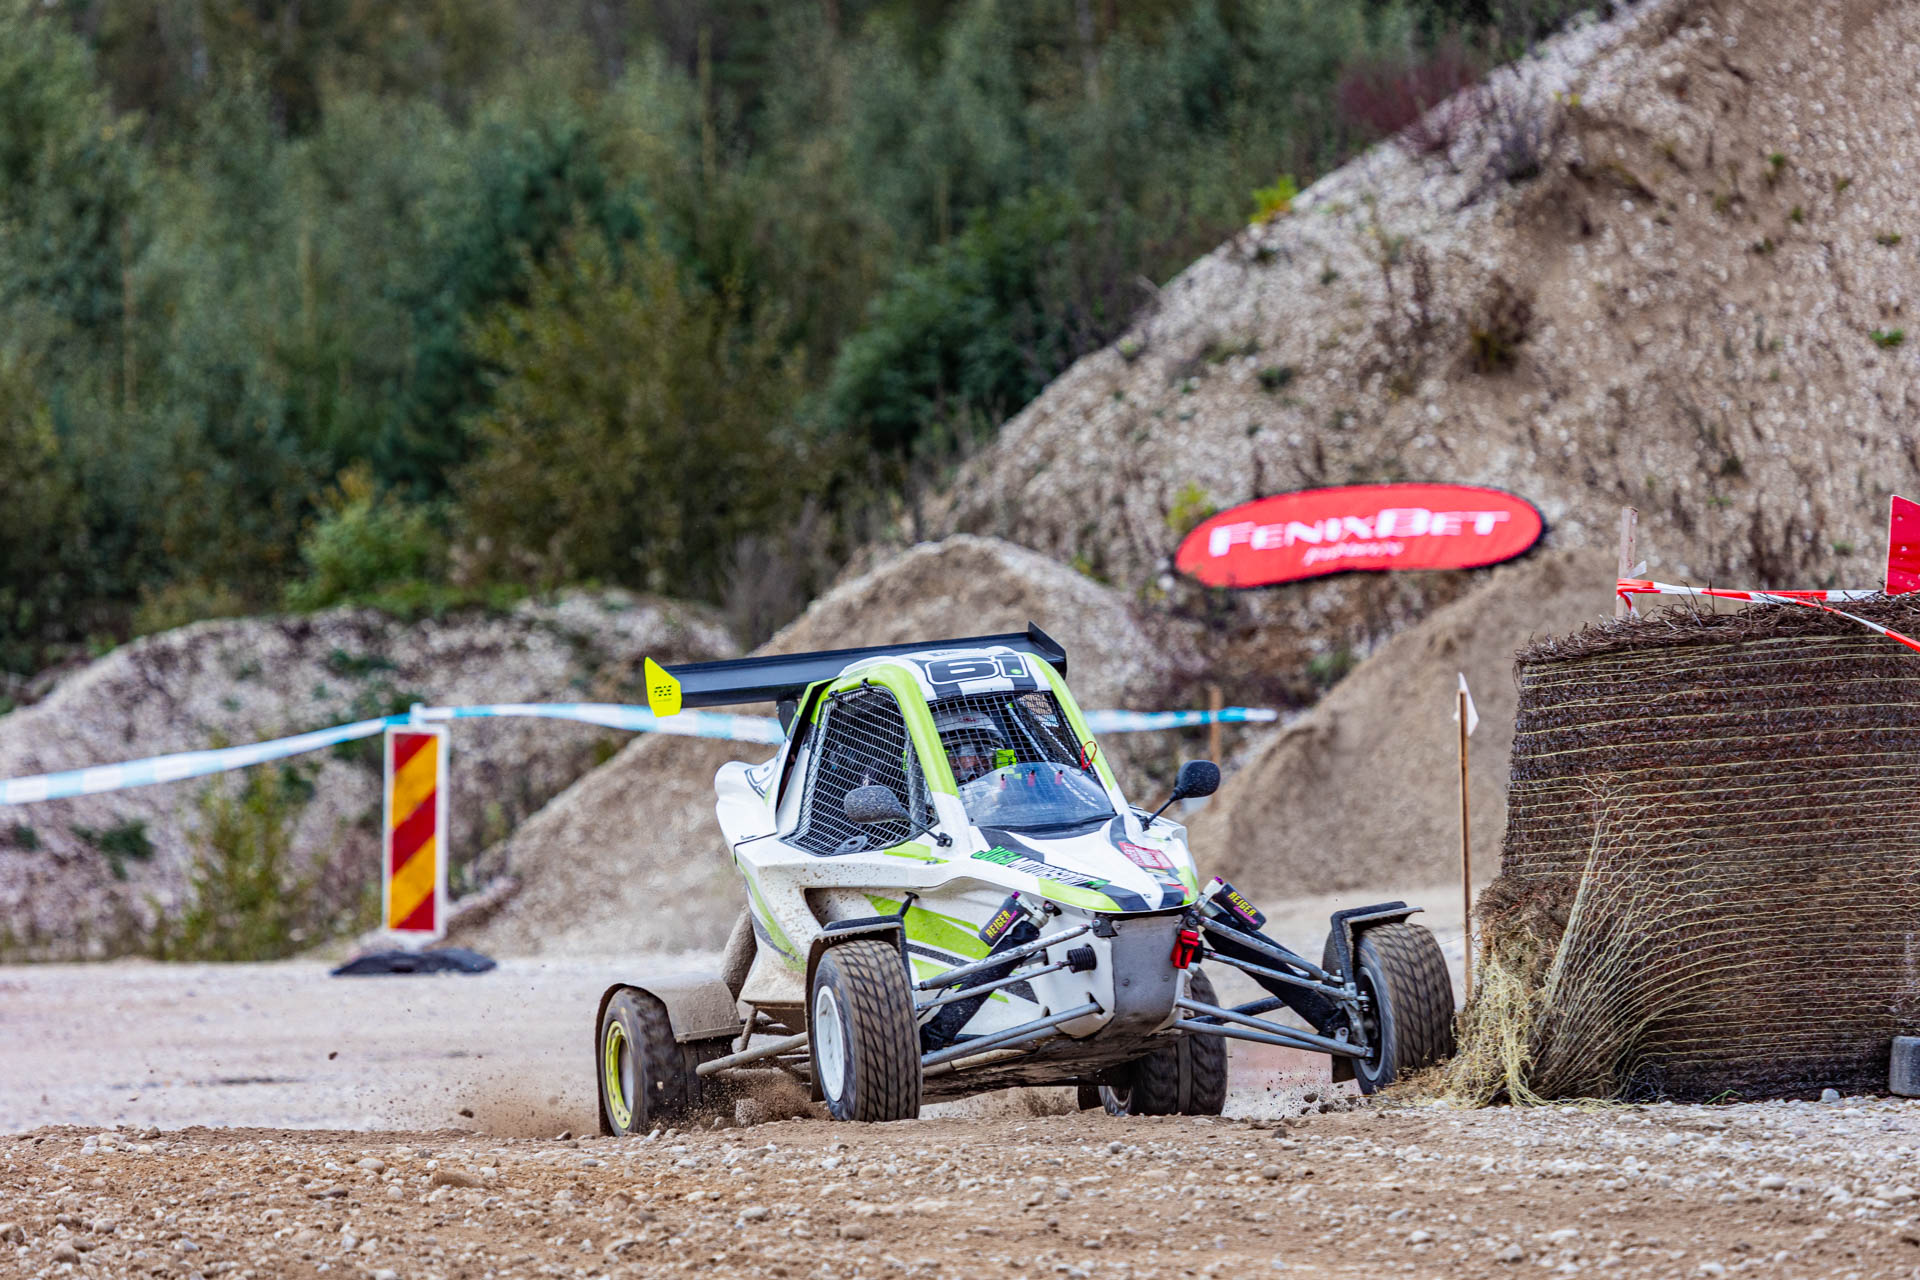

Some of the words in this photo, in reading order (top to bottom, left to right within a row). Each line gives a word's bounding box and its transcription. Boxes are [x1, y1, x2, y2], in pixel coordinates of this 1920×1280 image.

[925, 655, 1029, 685] 61
[1227, 891, 1257, 917] REIGER
[985, 910, 1011, 939] REIGER
